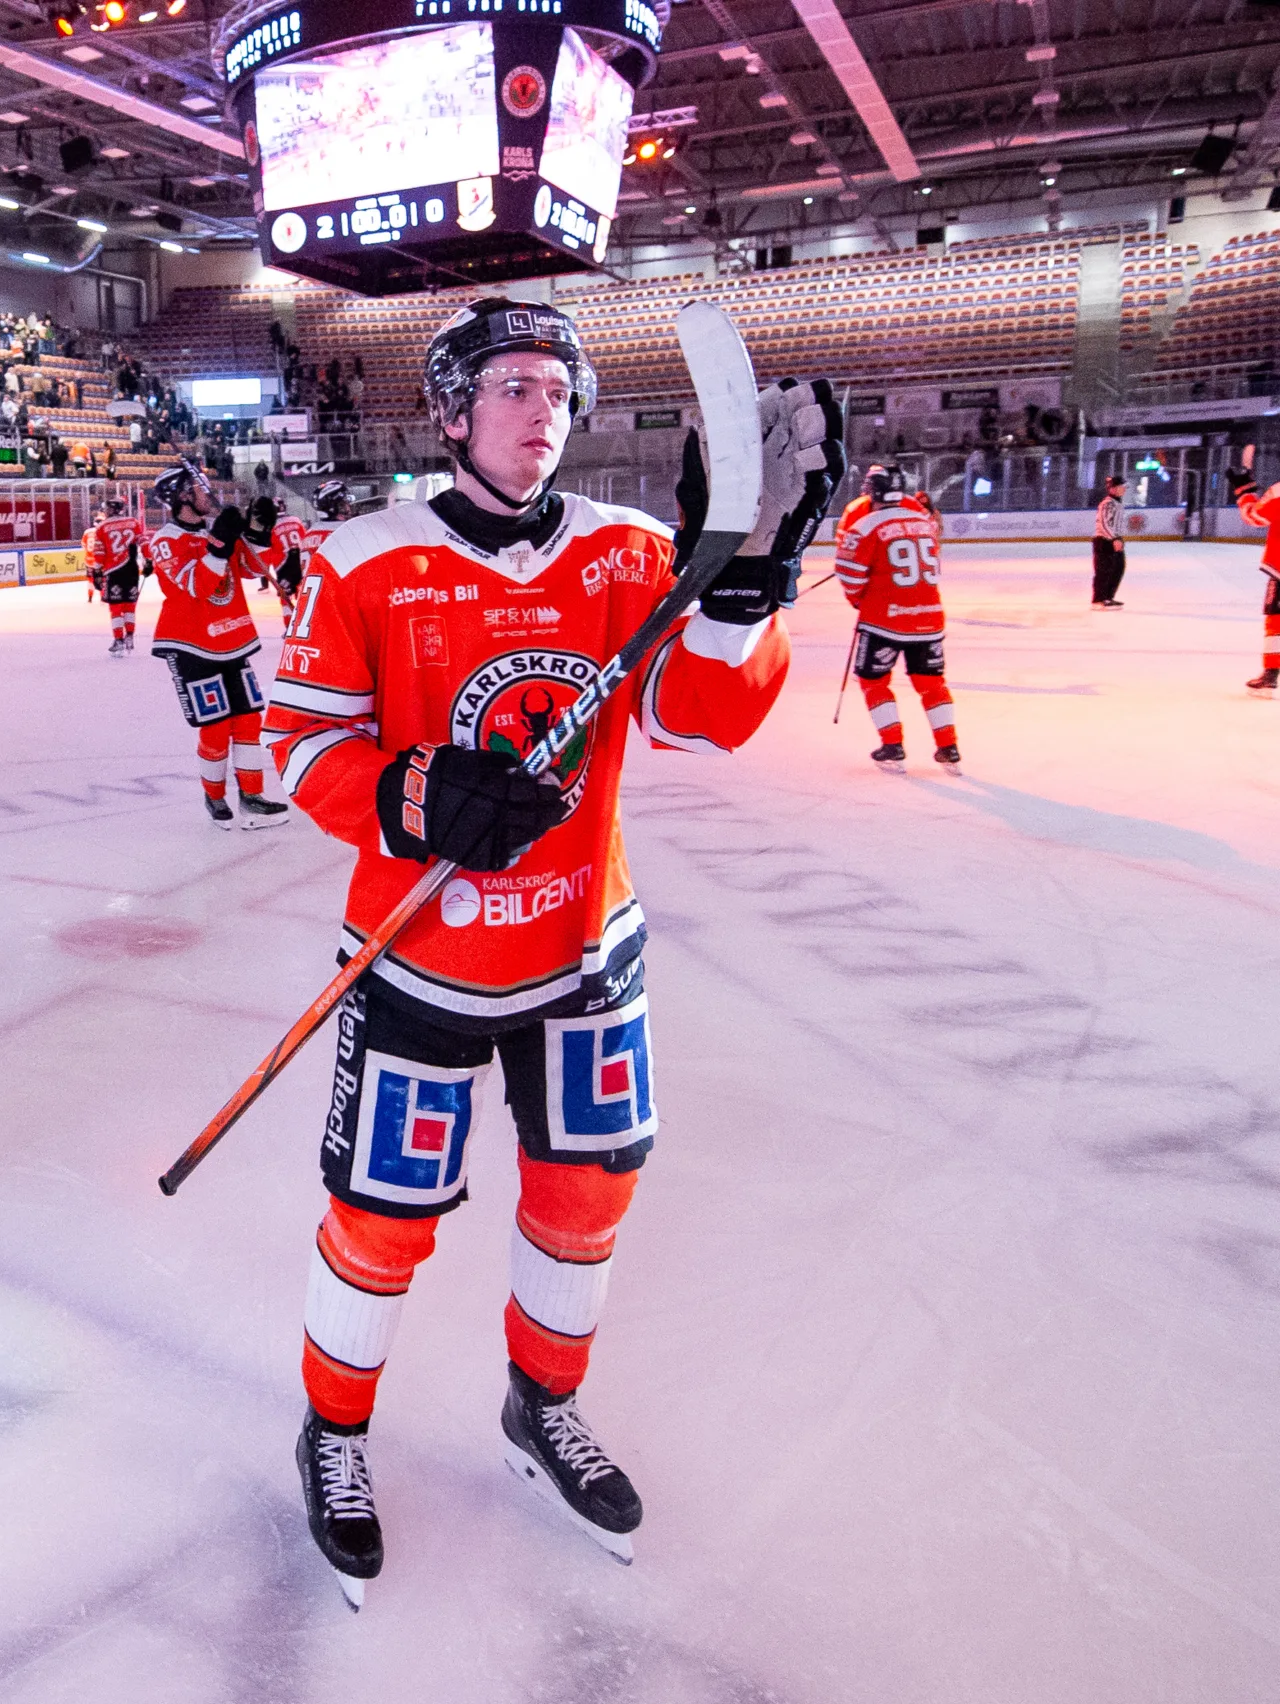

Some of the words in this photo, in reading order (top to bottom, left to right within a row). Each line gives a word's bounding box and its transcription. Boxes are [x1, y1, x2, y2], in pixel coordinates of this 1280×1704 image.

[317, 216, 333, 239] 2
[426, 199, 444, 223] 0
[533, 314, 564, 326] Louise
[291, 461, 335, 475] KIA
[109, 529, 135, 553] 22
[151, 541, 172, 562] 28
[280, 530, 300, 552] 19
[444, 531, 491, 560] TEAMGEAR
[541, 523, 570, 557] TEAMGEAR
[599, 547, 652, 572] MCT
[888, 538, 939, 587] 95
[454, 584, 478, 601] Bil
[712, 589, 762, 598] BAUER
[325, 1063, 357, 1157] Rock
